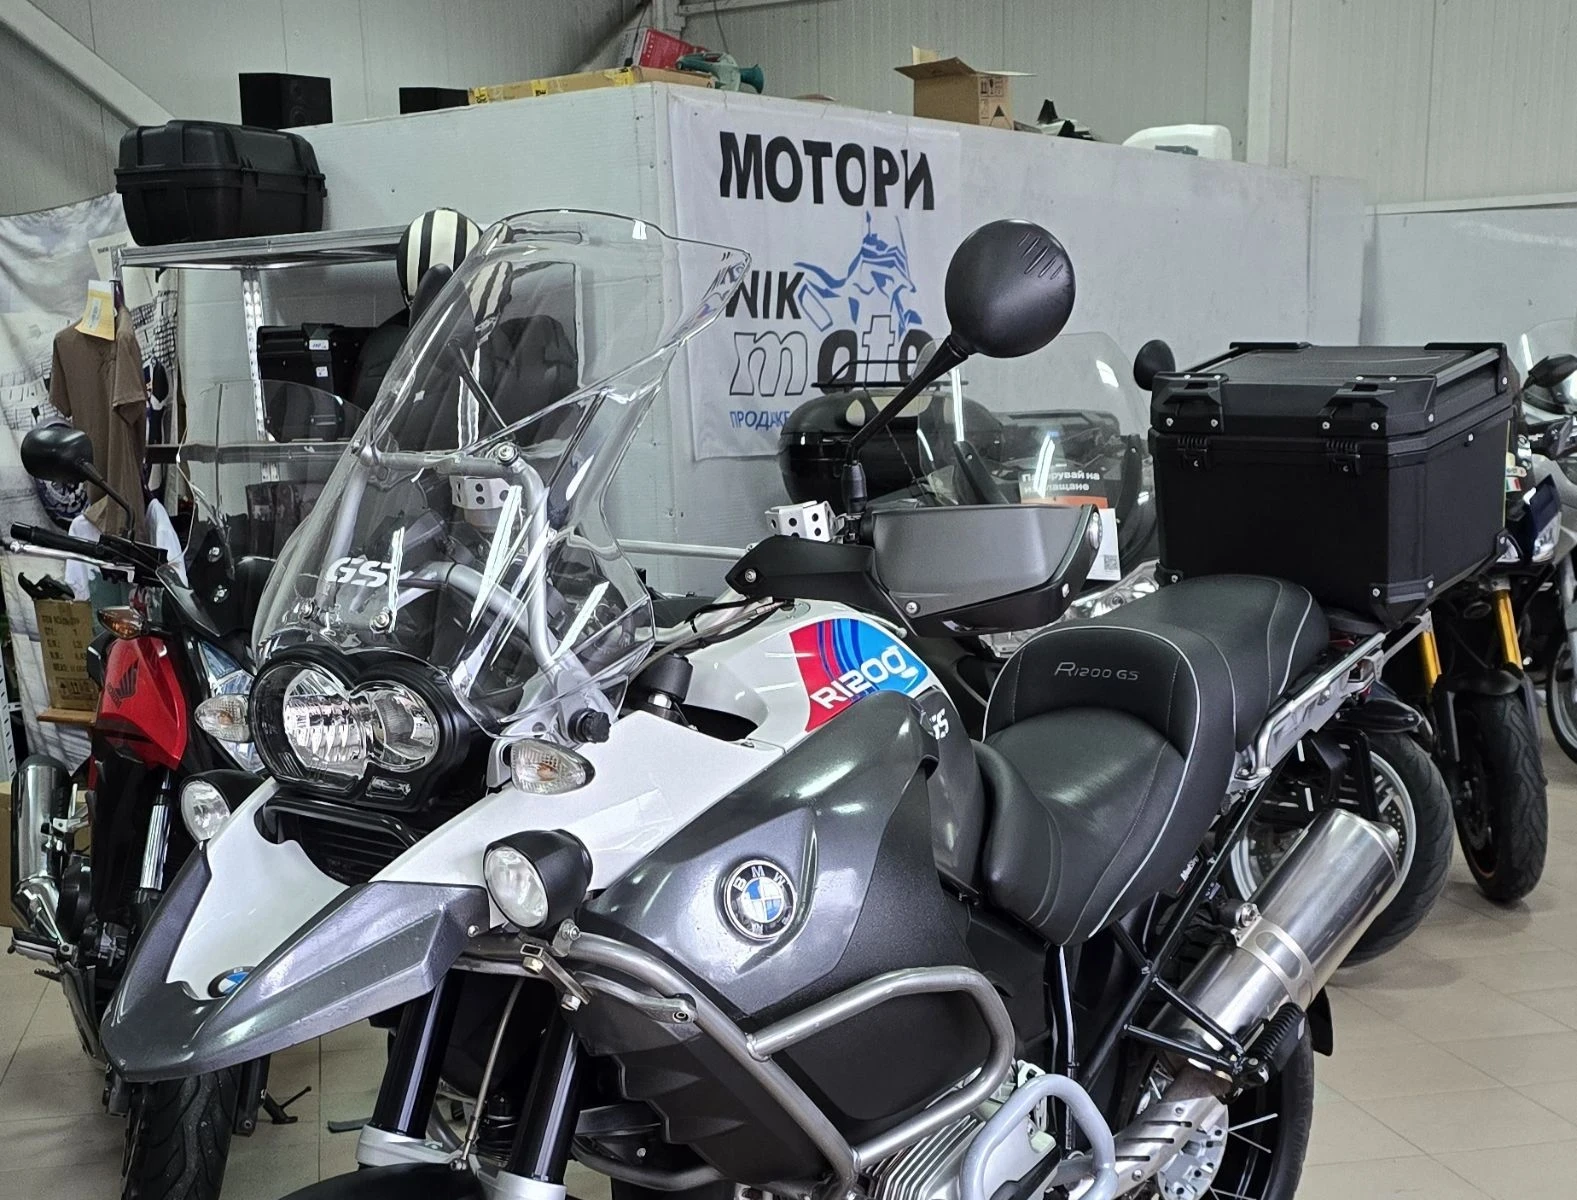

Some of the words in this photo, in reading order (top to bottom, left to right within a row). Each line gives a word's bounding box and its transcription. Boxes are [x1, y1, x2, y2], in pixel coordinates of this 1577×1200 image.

[719, 131, 935, 210] МОТОРИ
[725, 270, 806, 320] NIK
[1054, 661, 1113, 679] R1200
[1116, 669, 1139, 681] GS
[733, 865, 786, 892] BMW
